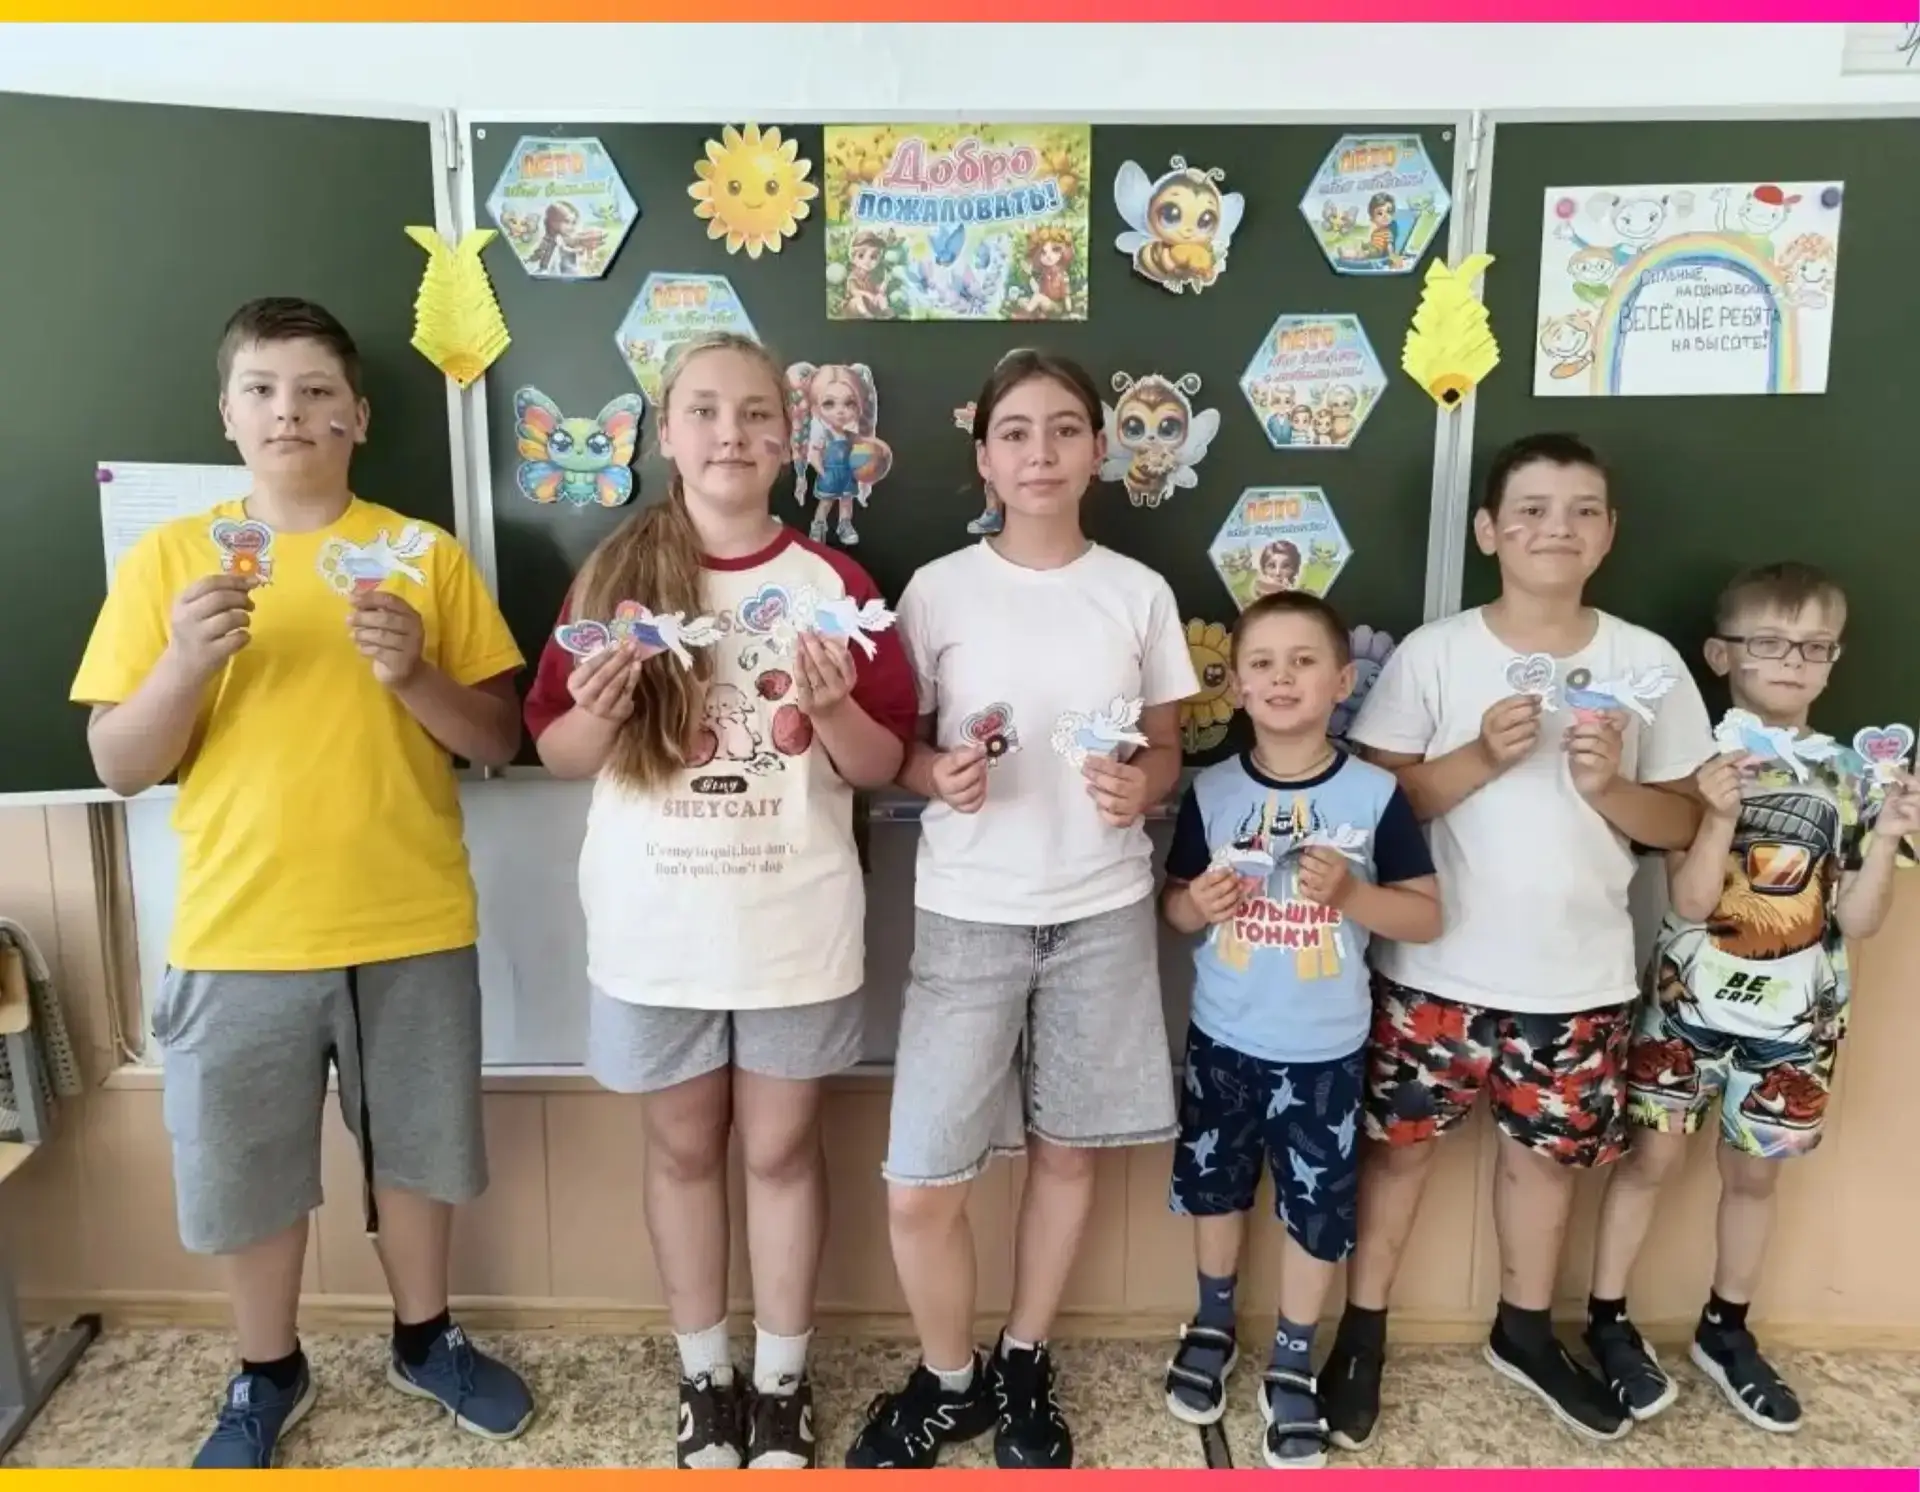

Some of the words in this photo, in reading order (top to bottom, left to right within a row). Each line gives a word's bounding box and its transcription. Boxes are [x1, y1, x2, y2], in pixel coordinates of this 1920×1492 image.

[884, 138, 1036, 192] Добро
[857, 182, 1058, 222] ПОЖАЛОВАТЬ!
[1619, 303, 1714, 334] ВЕСЁЛЫЕ
[1235, 899, 1341, 924] ОЛЬШИЕ
[1235, 920, 1320, 948] ГОНКИ
[1725, 971, 1771, 992] BE
